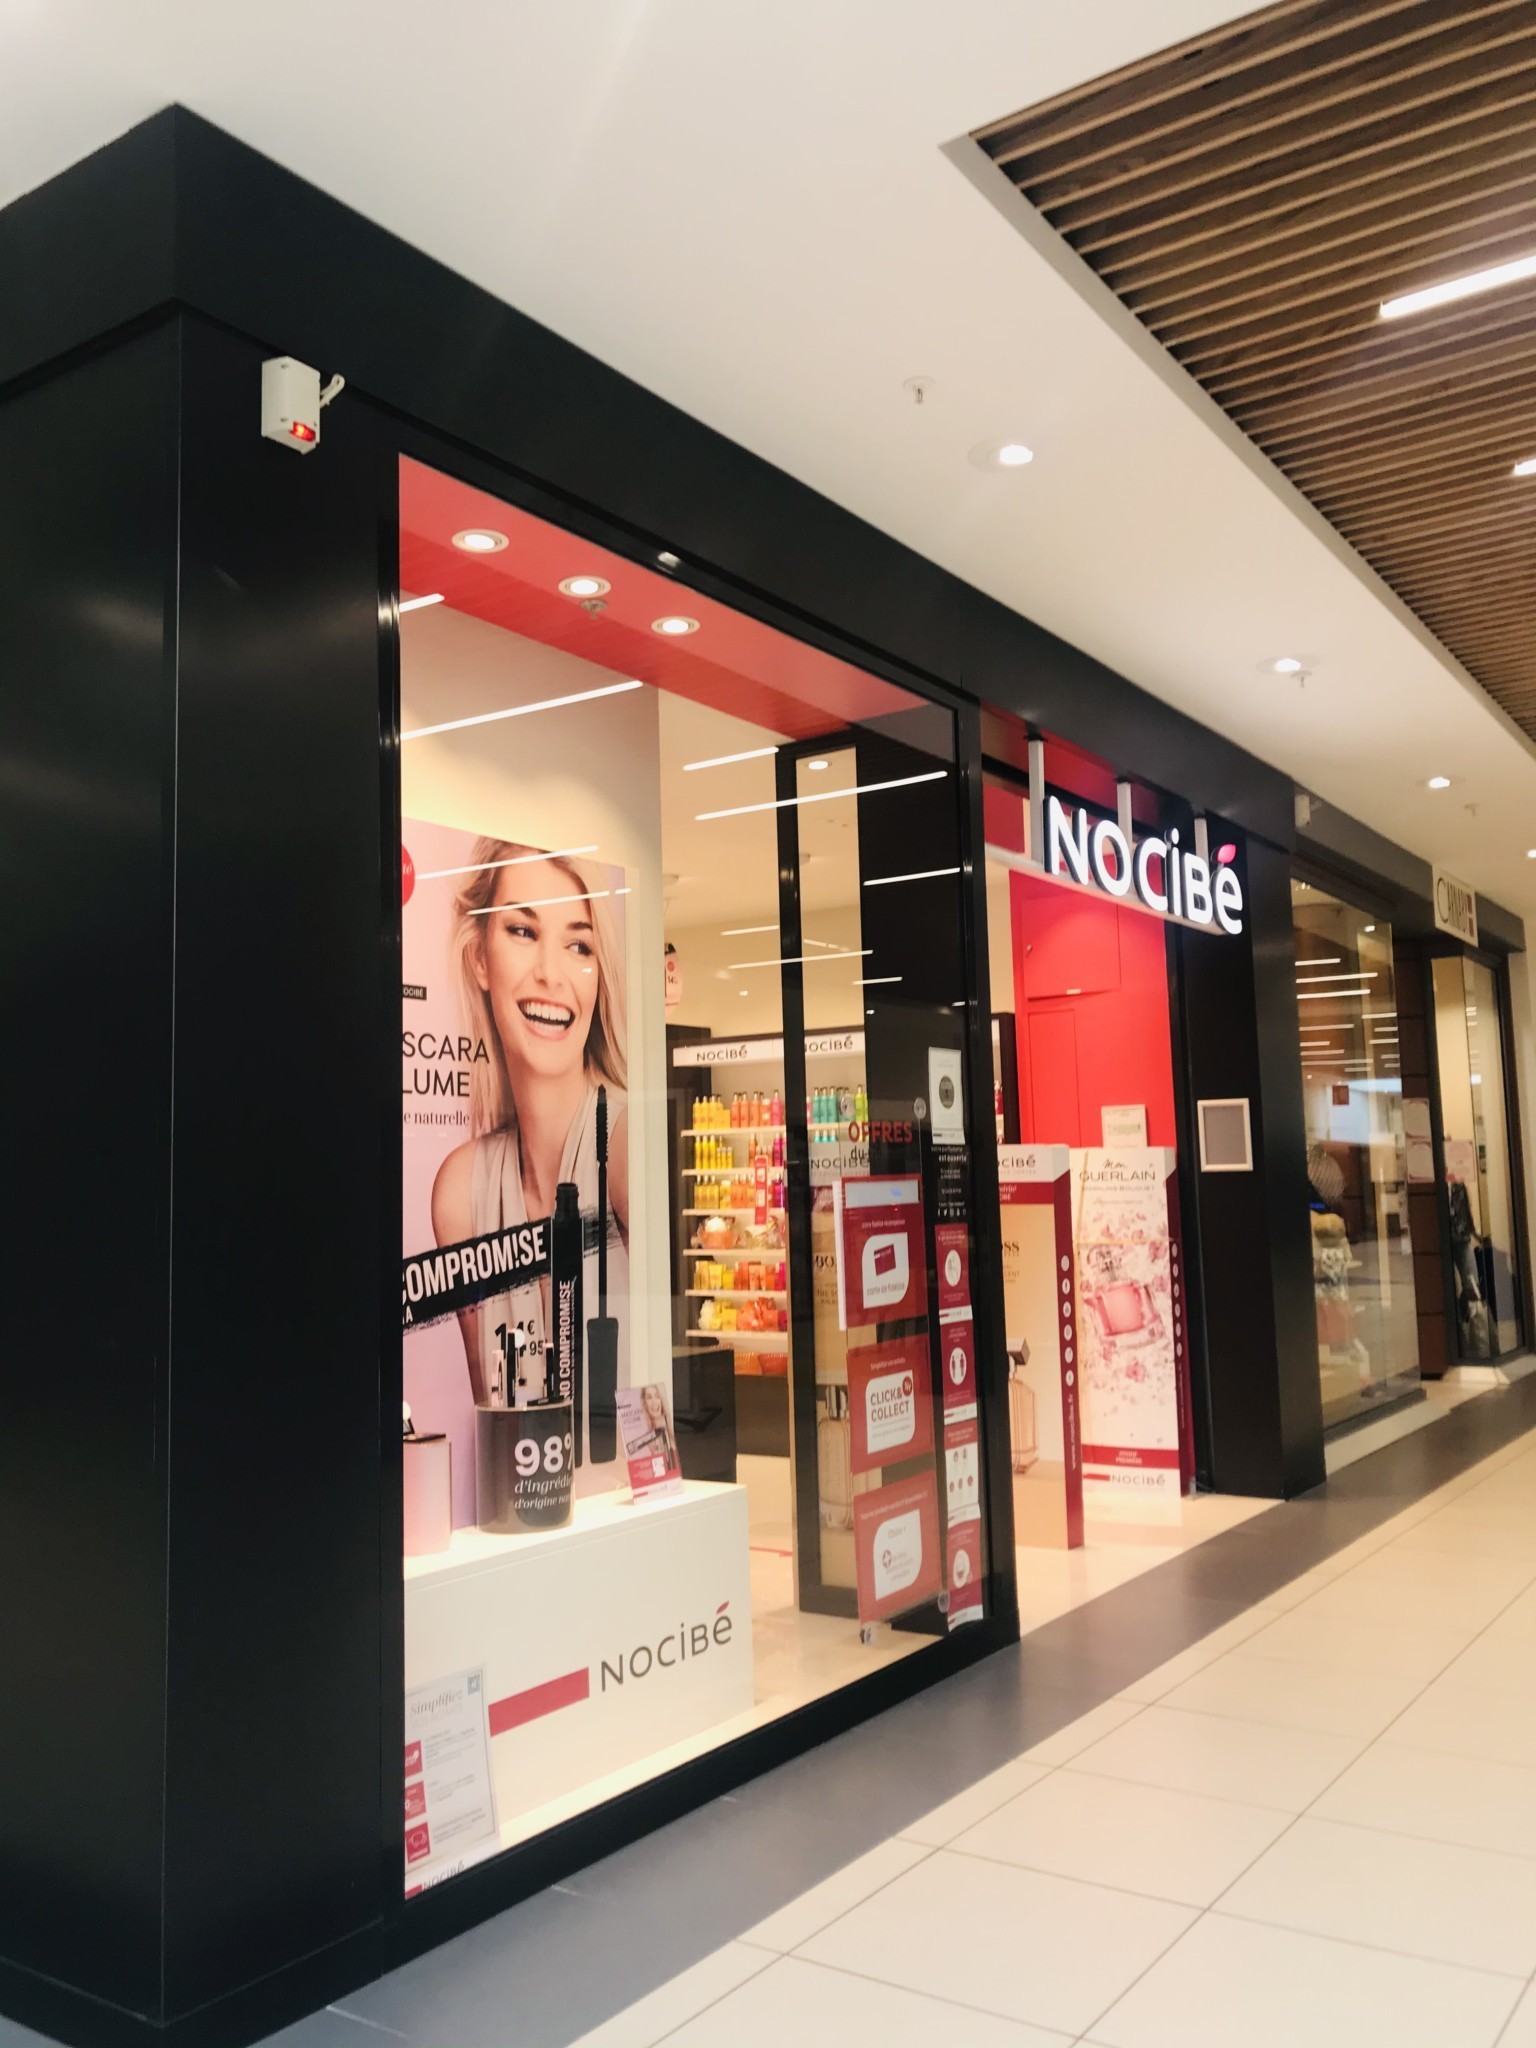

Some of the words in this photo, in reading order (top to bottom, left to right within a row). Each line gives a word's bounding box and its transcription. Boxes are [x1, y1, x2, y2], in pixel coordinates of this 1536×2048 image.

[414, 1110, 470, 1125] naturelle
[848, 1120, 913, 1143] OFFRES
[1079, 1170, 1156, 1182] GUERLAIN
[871, 1400, 910, 1422] COLLECT
[514, 1496, 557, 1511] d'origine
